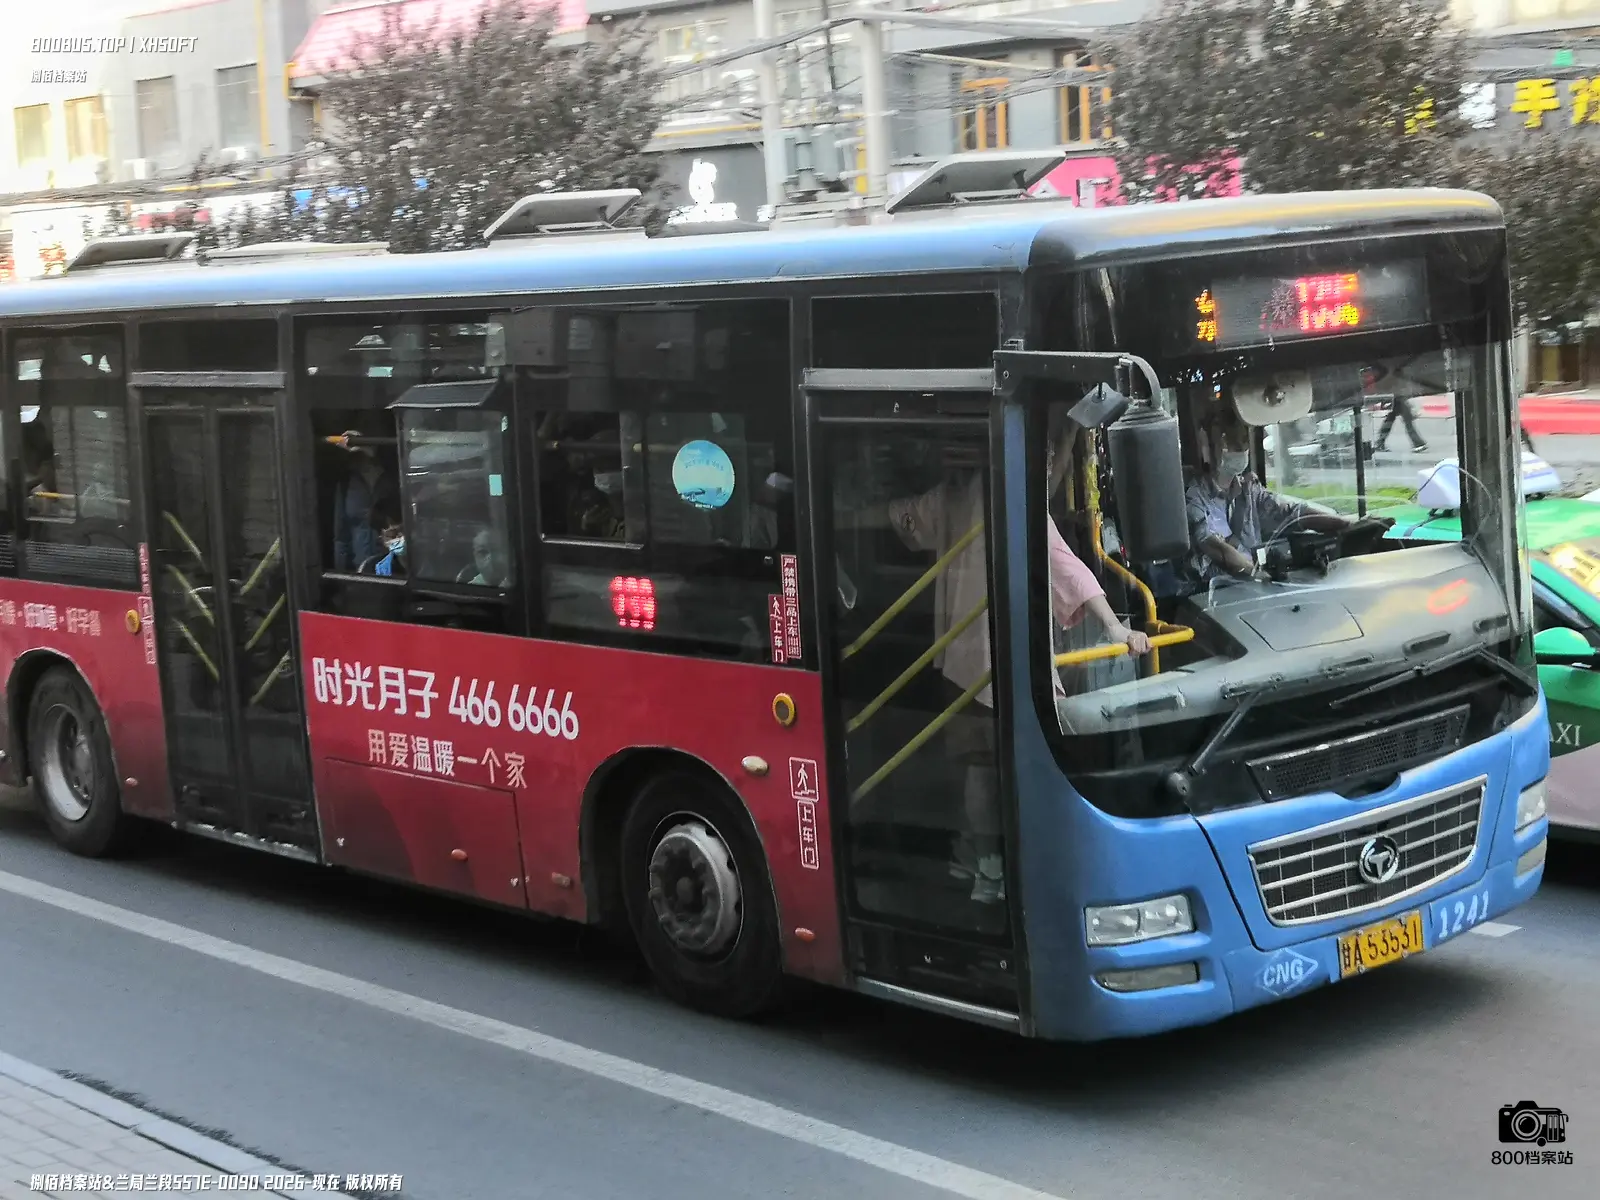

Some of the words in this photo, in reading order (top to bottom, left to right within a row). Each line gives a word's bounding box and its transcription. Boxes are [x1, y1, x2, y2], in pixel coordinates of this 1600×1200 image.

[774, 620, 784, 662] 上车门
[312, 657, 439, 719] 时光月子
[448, 676, 502, 728] 466
[508, 684, 579, 740] 6666
[368, 728, 528, 789] 用爱温暖一个家
[802, 805, 815, 864] 上车门
[1439, 890, 1489, 939] 1241
[1263, 958, 1303, 987] CNG
